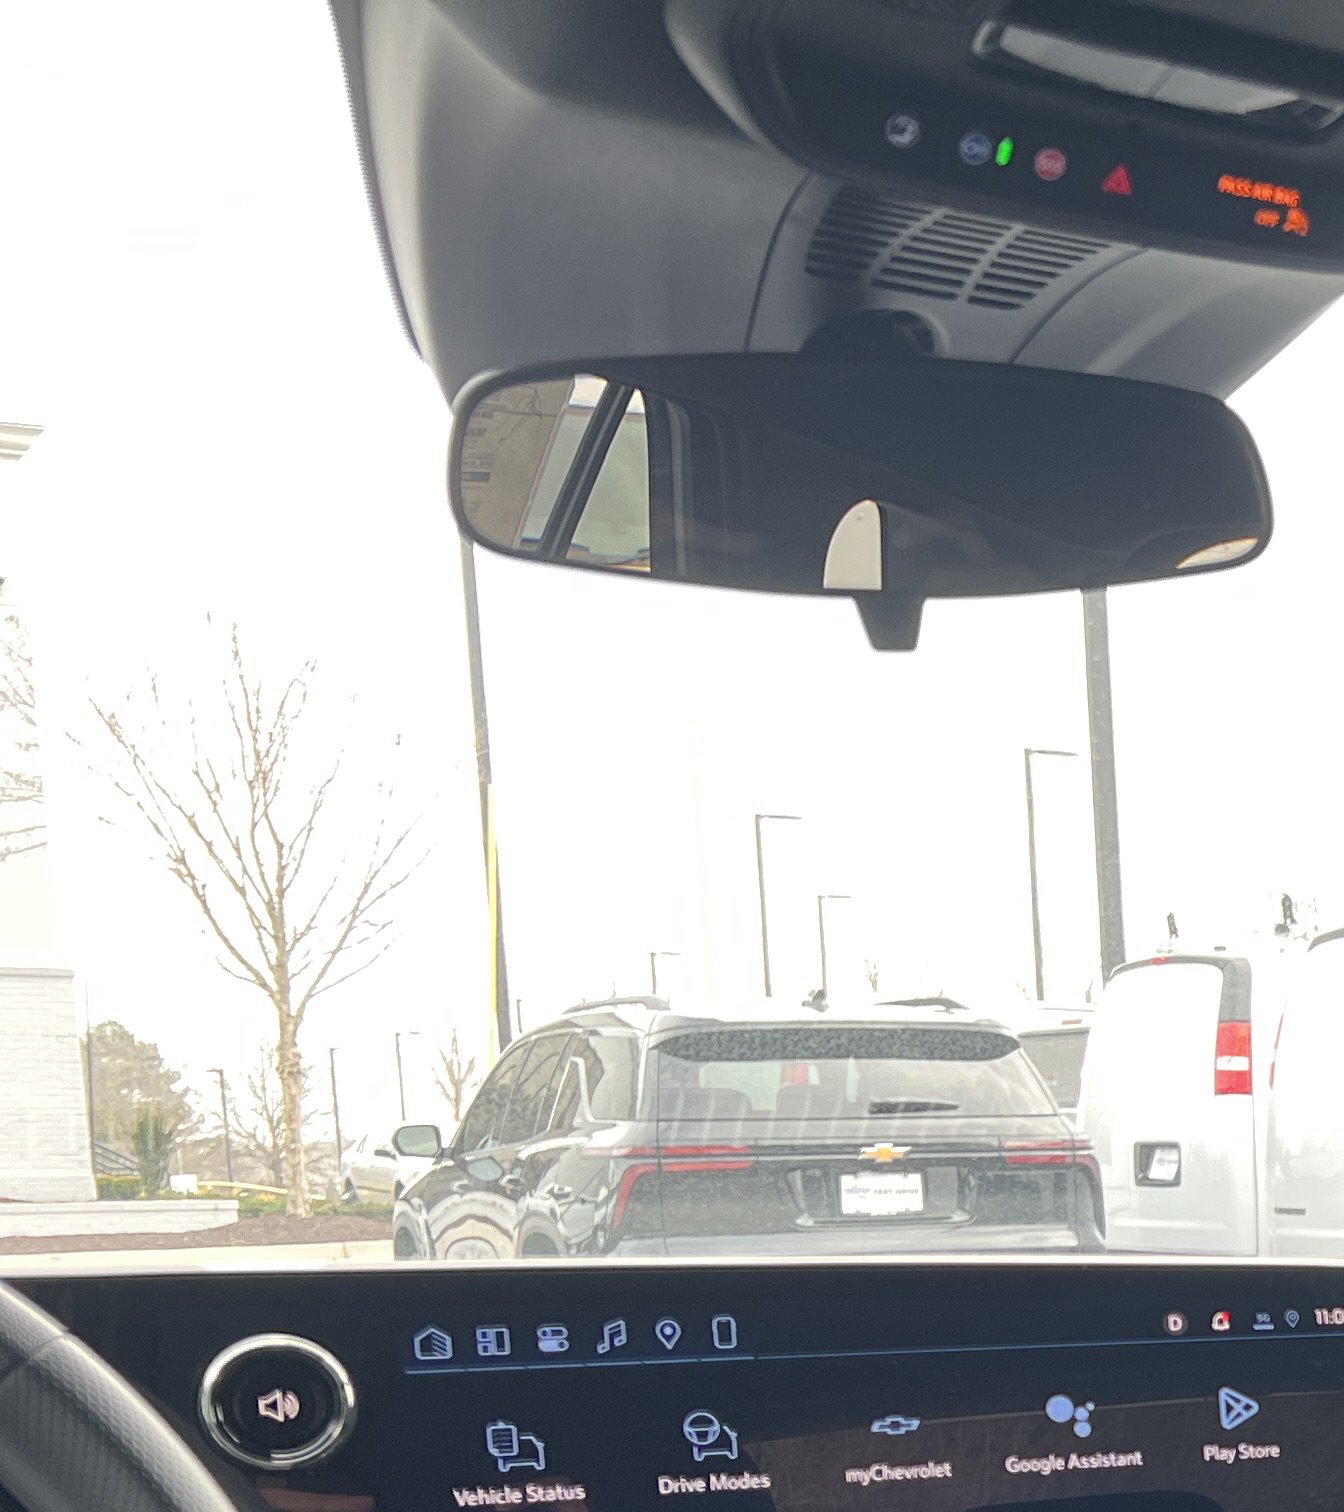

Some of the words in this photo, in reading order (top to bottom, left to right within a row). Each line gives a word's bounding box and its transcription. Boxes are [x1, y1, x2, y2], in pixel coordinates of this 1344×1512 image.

[1167, 1313, 1183, 1332] D
[1004, 1454, 1066, 1476] Google
[1068, 1449, 1143, 1469] Assistant
[1202, 1445, 1234, 1465] Play
[1237, 1443, 1281, 1461] Store
[657, 1474, 706, 1495] Drive
[709, 1471, 771, 1492] Modes
[845, 1460, 953, 1487] myChevrolet
[452, 1485, 522, 1509] Vehicle
[525, 1481, 586, 1504] Status
